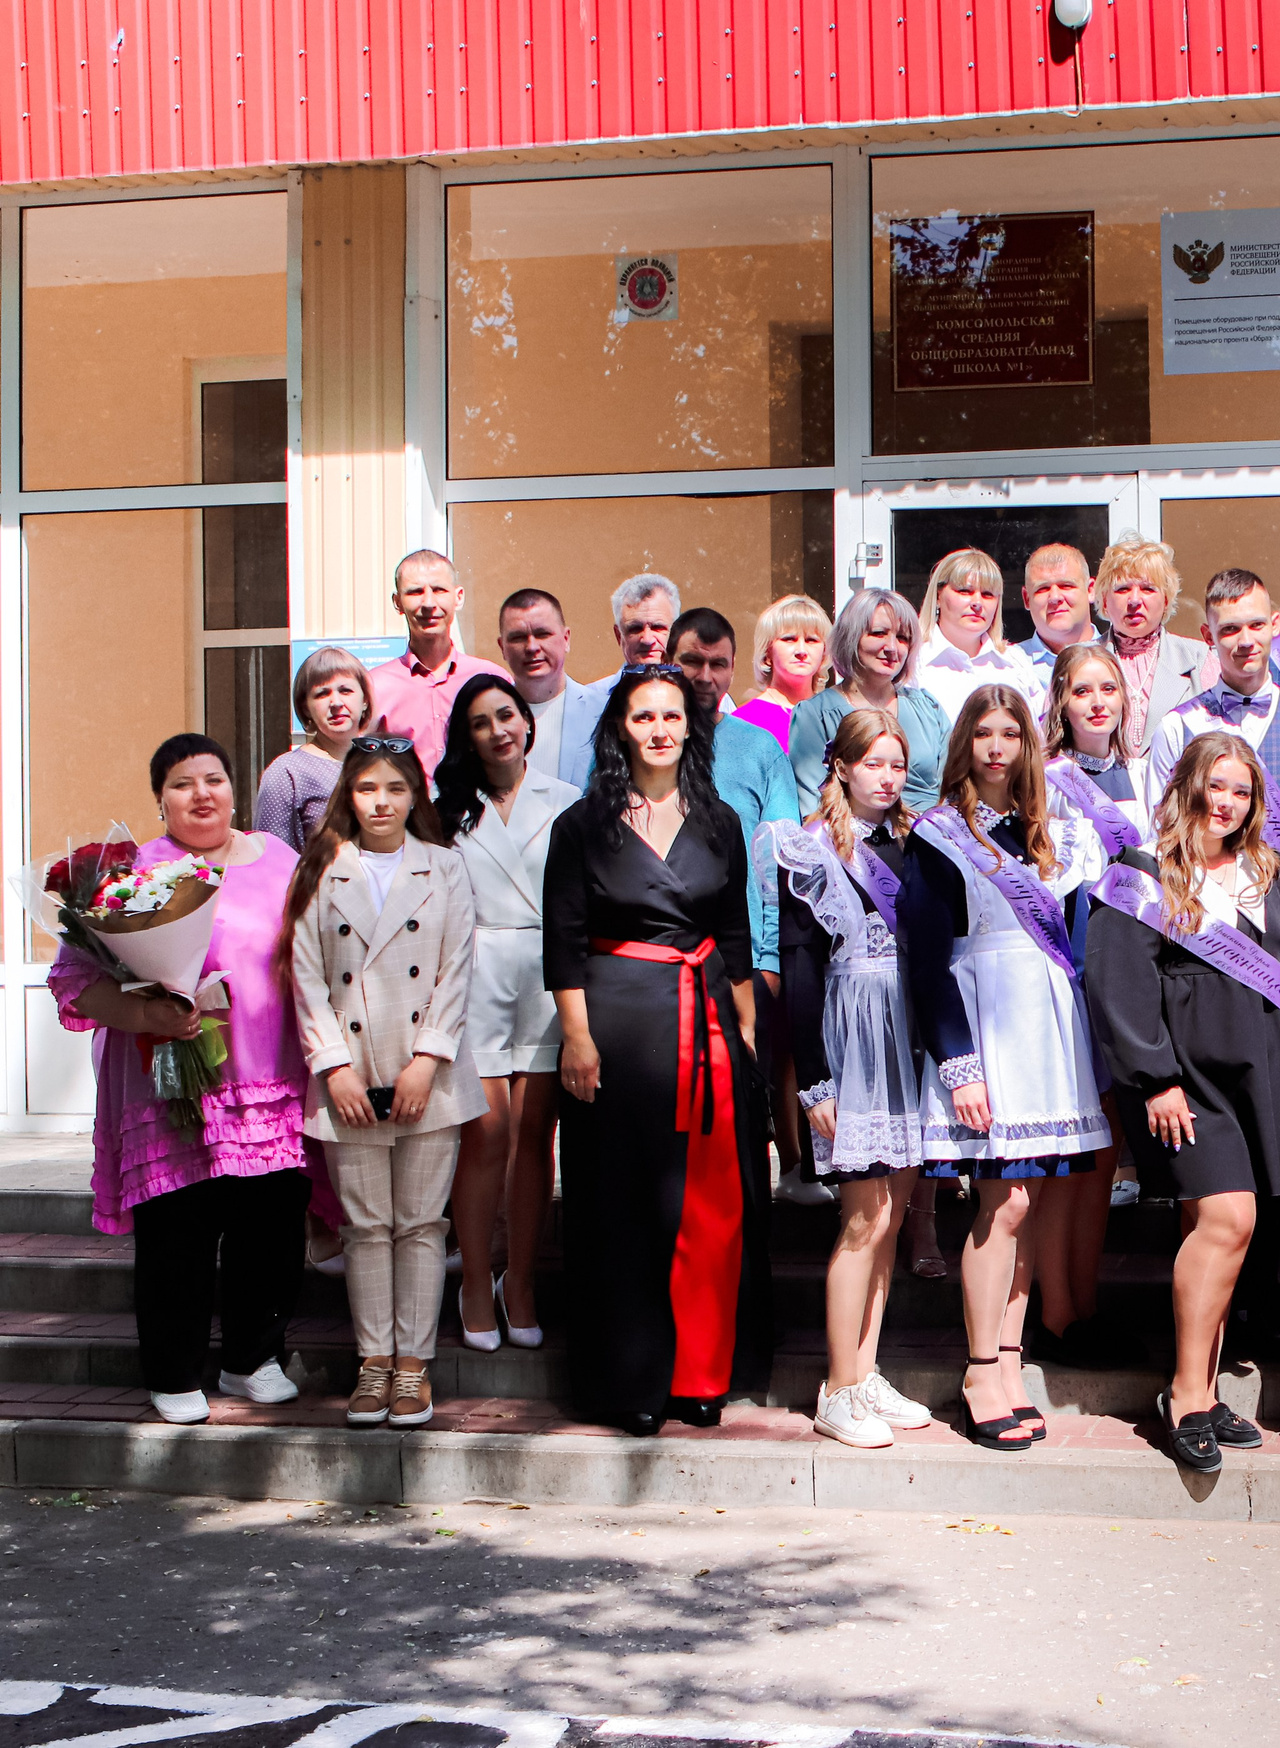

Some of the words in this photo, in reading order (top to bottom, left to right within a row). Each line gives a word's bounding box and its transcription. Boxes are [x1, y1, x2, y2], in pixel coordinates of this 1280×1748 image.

[1230, 258, 1280, 268] РОССИЙСКОЙ
[619, 258, 649, 286] ОХРАНЯЕТСЯ
[1230, 267, 1276, 276] ФЕДЕРАЦИИ
[1213, 316, 1253, 324] оборудовано
[1174, 327, 1217, 336] просвещения
[961, 332, 1020, 344] СРЕДНЯЯ
[1174, 338, 1222, 346] национального
[910, 345, 1074, 361] ОБЩЕОБРАЗОВАТЕЛЬНАЯ
[953, 363, 1000, 374] ШКОЛА
[1206, 921, 1247, 951] Арискина
[1248, 946, 1271, 968] Дарья
